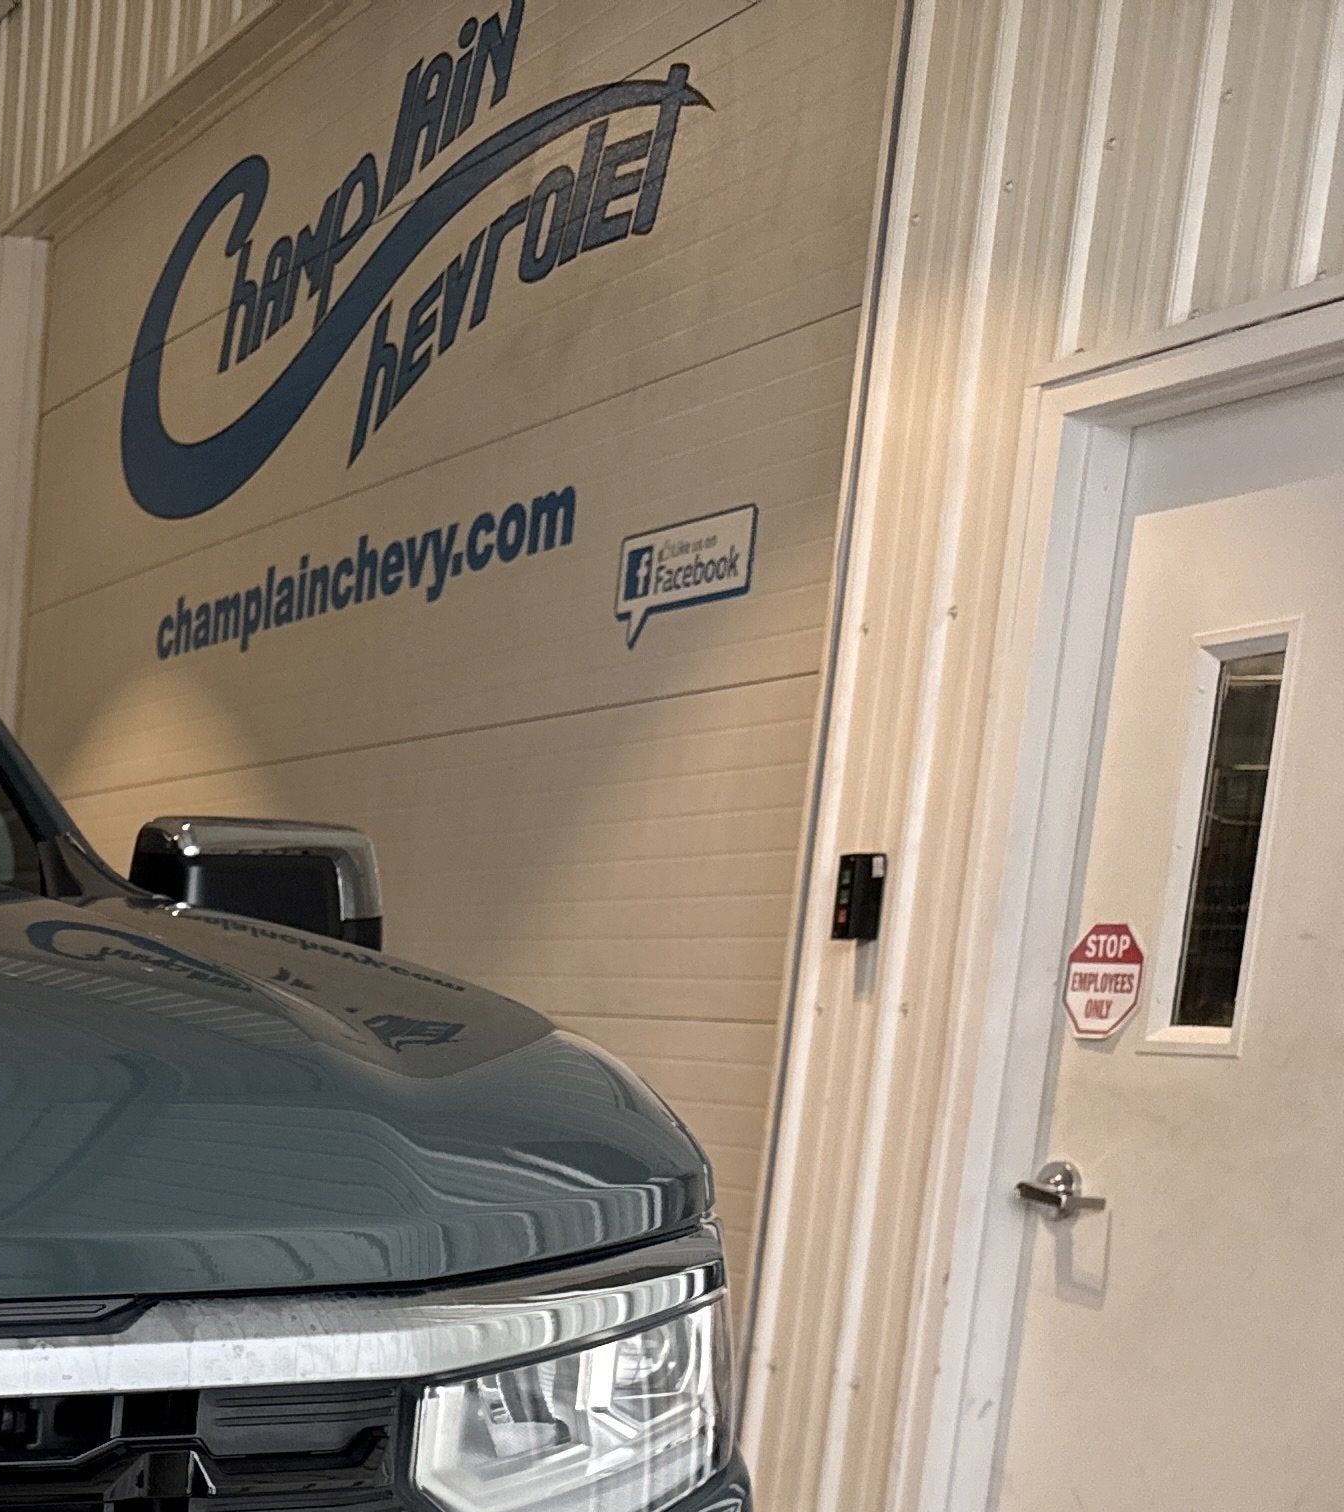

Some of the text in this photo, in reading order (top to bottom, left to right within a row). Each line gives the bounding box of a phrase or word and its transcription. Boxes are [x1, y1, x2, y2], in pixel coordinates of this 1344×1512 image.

[155, 485, 577, 661] champlainchevy.com
[653, 545, 740, 596] Facebook
[1084, 933, 1132, 959] STOP
[1070, 971, 1135, 994] EMPLOYEES
[1083, 998, 1113, 1020] ONLY
